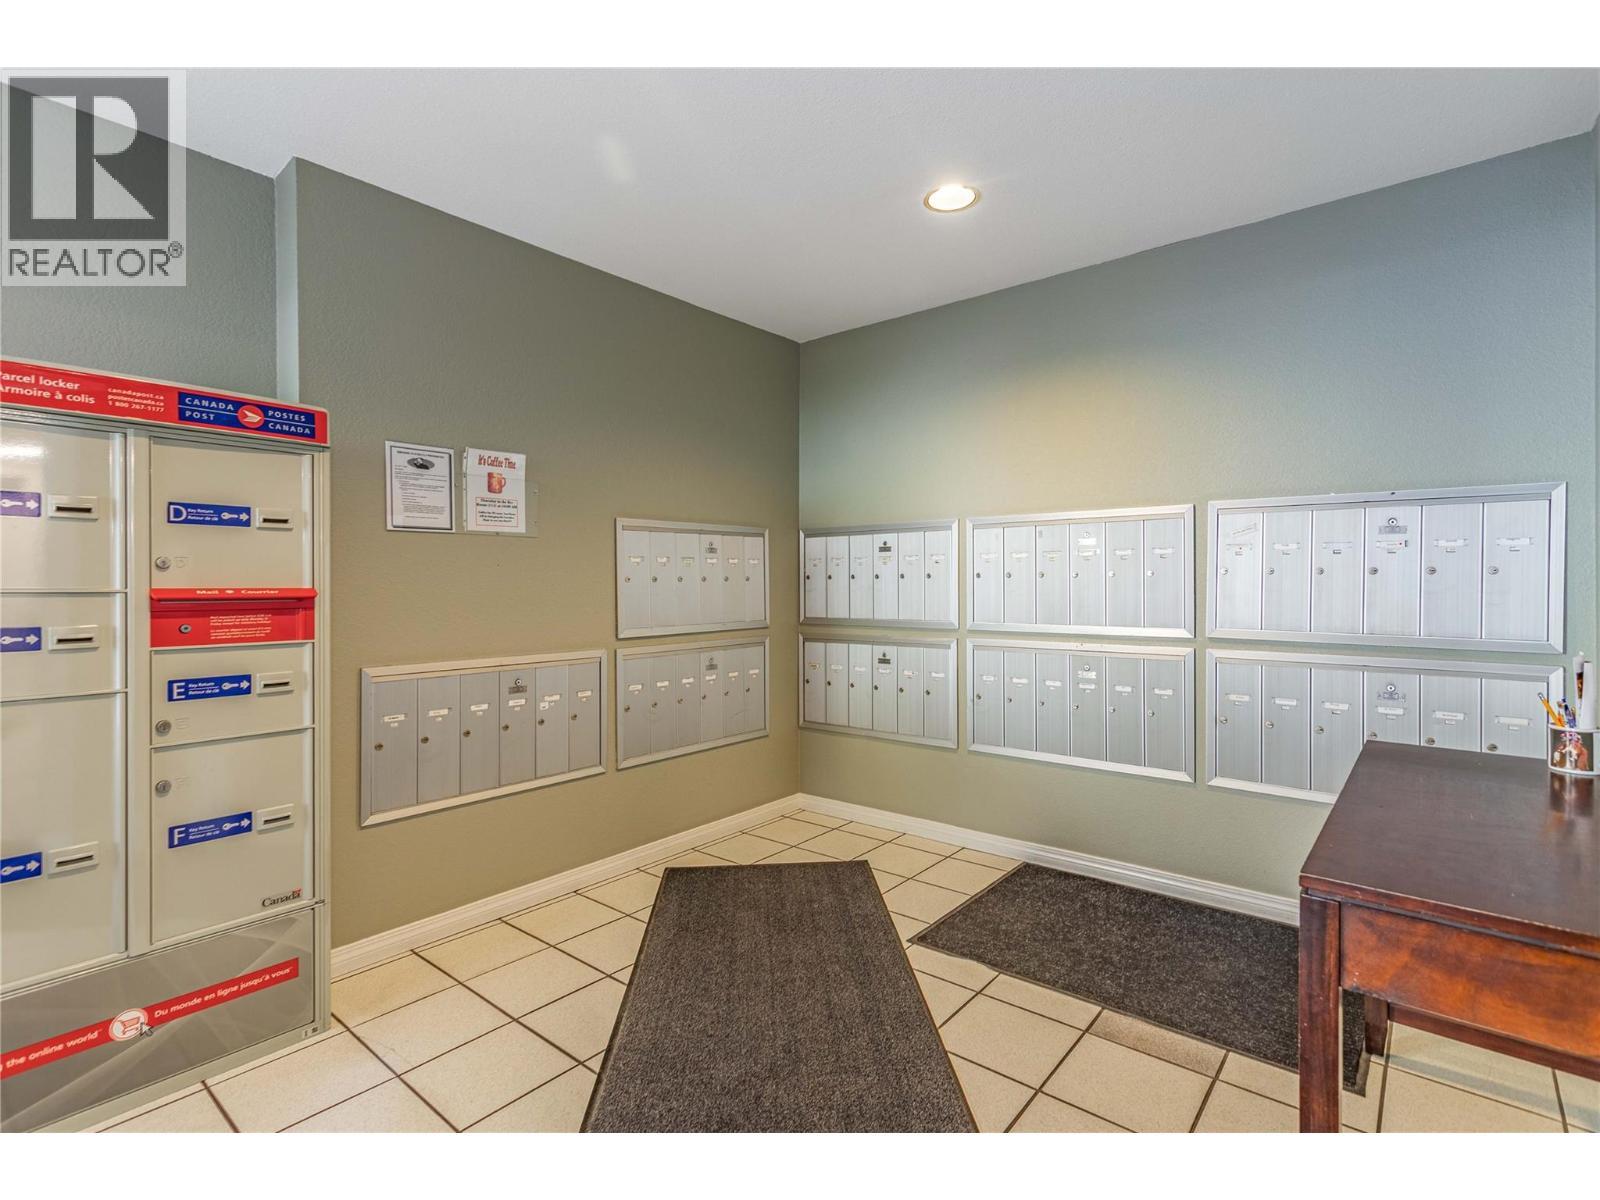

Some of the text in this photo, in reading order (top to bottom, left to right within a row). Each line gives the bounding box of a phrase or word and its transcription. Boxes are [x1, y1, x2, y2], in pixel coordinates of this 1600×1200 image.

[0, 370, 80, 390] arcel locker
[54, 390, 63, 400] à
[66, 393, 96, 404] colis
[185, 397, 235, 411] CANADA
[185, 410, 216, 421] POST
[268, 410, 306, 422] POSTES
[268, 422, 311, 435] CANADA
[169, 505, 187, 521] D
[172, 682, 186, 699] E
[174, 827, 186, 845] F
[154, 1008, 168, 1018] Du
[170, 997, 202, 1012] monde
[204, 993, 216, 1001] en
[217, 985, 239, 997] ligne
[6, 1030, 99, 1068] the online world
